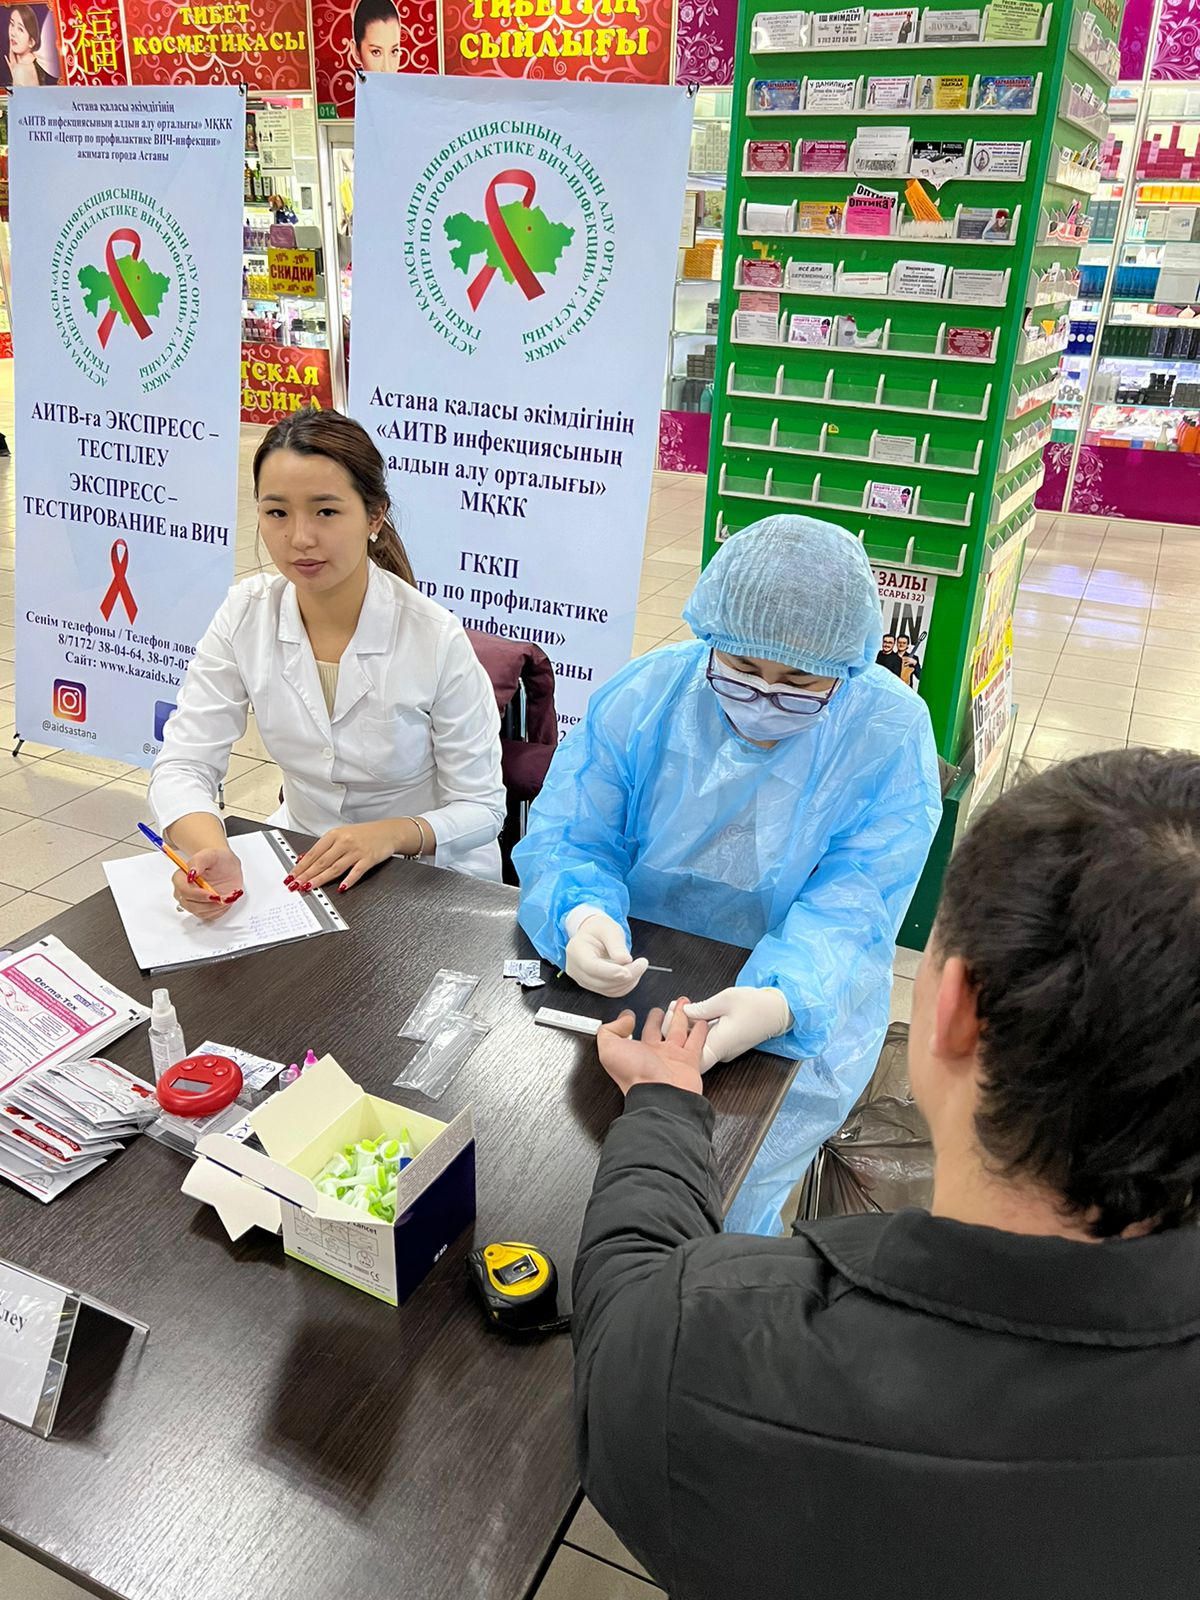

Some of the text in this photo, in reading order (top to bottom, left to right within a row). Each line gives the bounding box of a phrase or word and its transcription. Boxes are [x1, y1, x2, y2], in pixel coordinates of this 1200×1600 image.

[179, 4, 250, 26] ТИБЕТ
[70, 8, 118, 73] 福
[133, 31, 306, 56] КОСМЕТИКАСЫ
[460, 23, 650, 59] СЫЙЛЫҒЫ
[18, 115, 46, 127] «АИТВ
[47, 116, 112, 130] инфекциясының
[114, 119, 139, 129] алдын
[141, 121, 154, 131] алу
[205, 118, 232, 131] МҚКК
[72, 101, 175, 113] Астана қаласы әкімдігінің
[319, 106, 336, 117] 014
[29, 131, 221, 148] ГККП «Центр по профилактике ВИЧ-инфекции»
[77, 150, 169, 163] акимата города Астаны
[422, 120, 562, 182] ИНФЕКЦИЯСЫНЫҢ
[562, 143, 606, 196] АЛДЫН
[60, 188, 157, 240] ИНФЕКЦИЯСЫНЫҢ
[406, 182, 427, 236] «АИТВ
[598, 200, 616, 234] АЛУ
[64, 205, 138, 267] ПРОФИЛАКТИКЕ
[156, 206, 190, 249] АЛДЫН
[420, 140, 598, 345] ГККП «ЦЕНТР ПО ПРОФИЛАКТИКЕ ВИЧ-ИНФЕКЦИИ» Г. АСТАНЫ
[51, 240, 65, 285] «АИТВ
[61, 269, 71, 290] ПО
[140, 210, 188, 323] ВИЧ-ИНФЕКЦИИ»
[185, 254, 199, 281] АЛУ
[270, 264, 314, 283] СКИДКИ
[403, 241, 430, 311] ҚАЛАСЫ
[62, 295, 84, 346] «ЦЕНТР
[428, 311, 477, 356] АСТАНА
[83, 347, 110, 374] ГККП
[139, 337, 177, 378] АСТАНЫ
[524, 335, 567, 363] МҚКК
[71, 349, 108, 387] АСТАНА
[240, 360, 320, 386] ТСКАЯ
[241, 388, 322, 412] ЕТИКА
[369, 385, 635, 436] Астана қаласы әкімдігінің
[31, 401, 101, 428] АИТВ-ға
[105, 410, 205, 441] ЭКСПРЕСС
[77, 437, 169, 468] ТЕСТІЛЕУ
[376, 418, 624, 469] «АИТВ инфекциясының
[388, 455, 607, 497] алдын алу орталығы»
[23, 495, 230, 547] ТЕСТИРОВАНИЕ на ВИЧ
[460, 490, 528, 519] МҚКК
[459, 551, 520, 579] ГККП
[877, 571, 928, 592] ЗАЛЫ
[443, 583, 464, 601] по
[470, 586, 609, 624] профилактике
[878, 588, 925, 604] ЕСАРЫ 32)
[26, 610, 58, 627] Сенім
[61, 619, 116, 638] телефоны
[125, 629, 170, 650] Телефон
[172, 642, 197, 656] дове
[58, 632, 97, 651] 8/7172/
[98, 640, 145, 663] 38-04-64,
[65, 650, 181, 687] Сайт: www.kazaids.kz
[42, 719, 97, 740] @aidsastana
[34, 976, 79, 1012] Derma-Tex
[0, 1311, 27, 1333] леу
